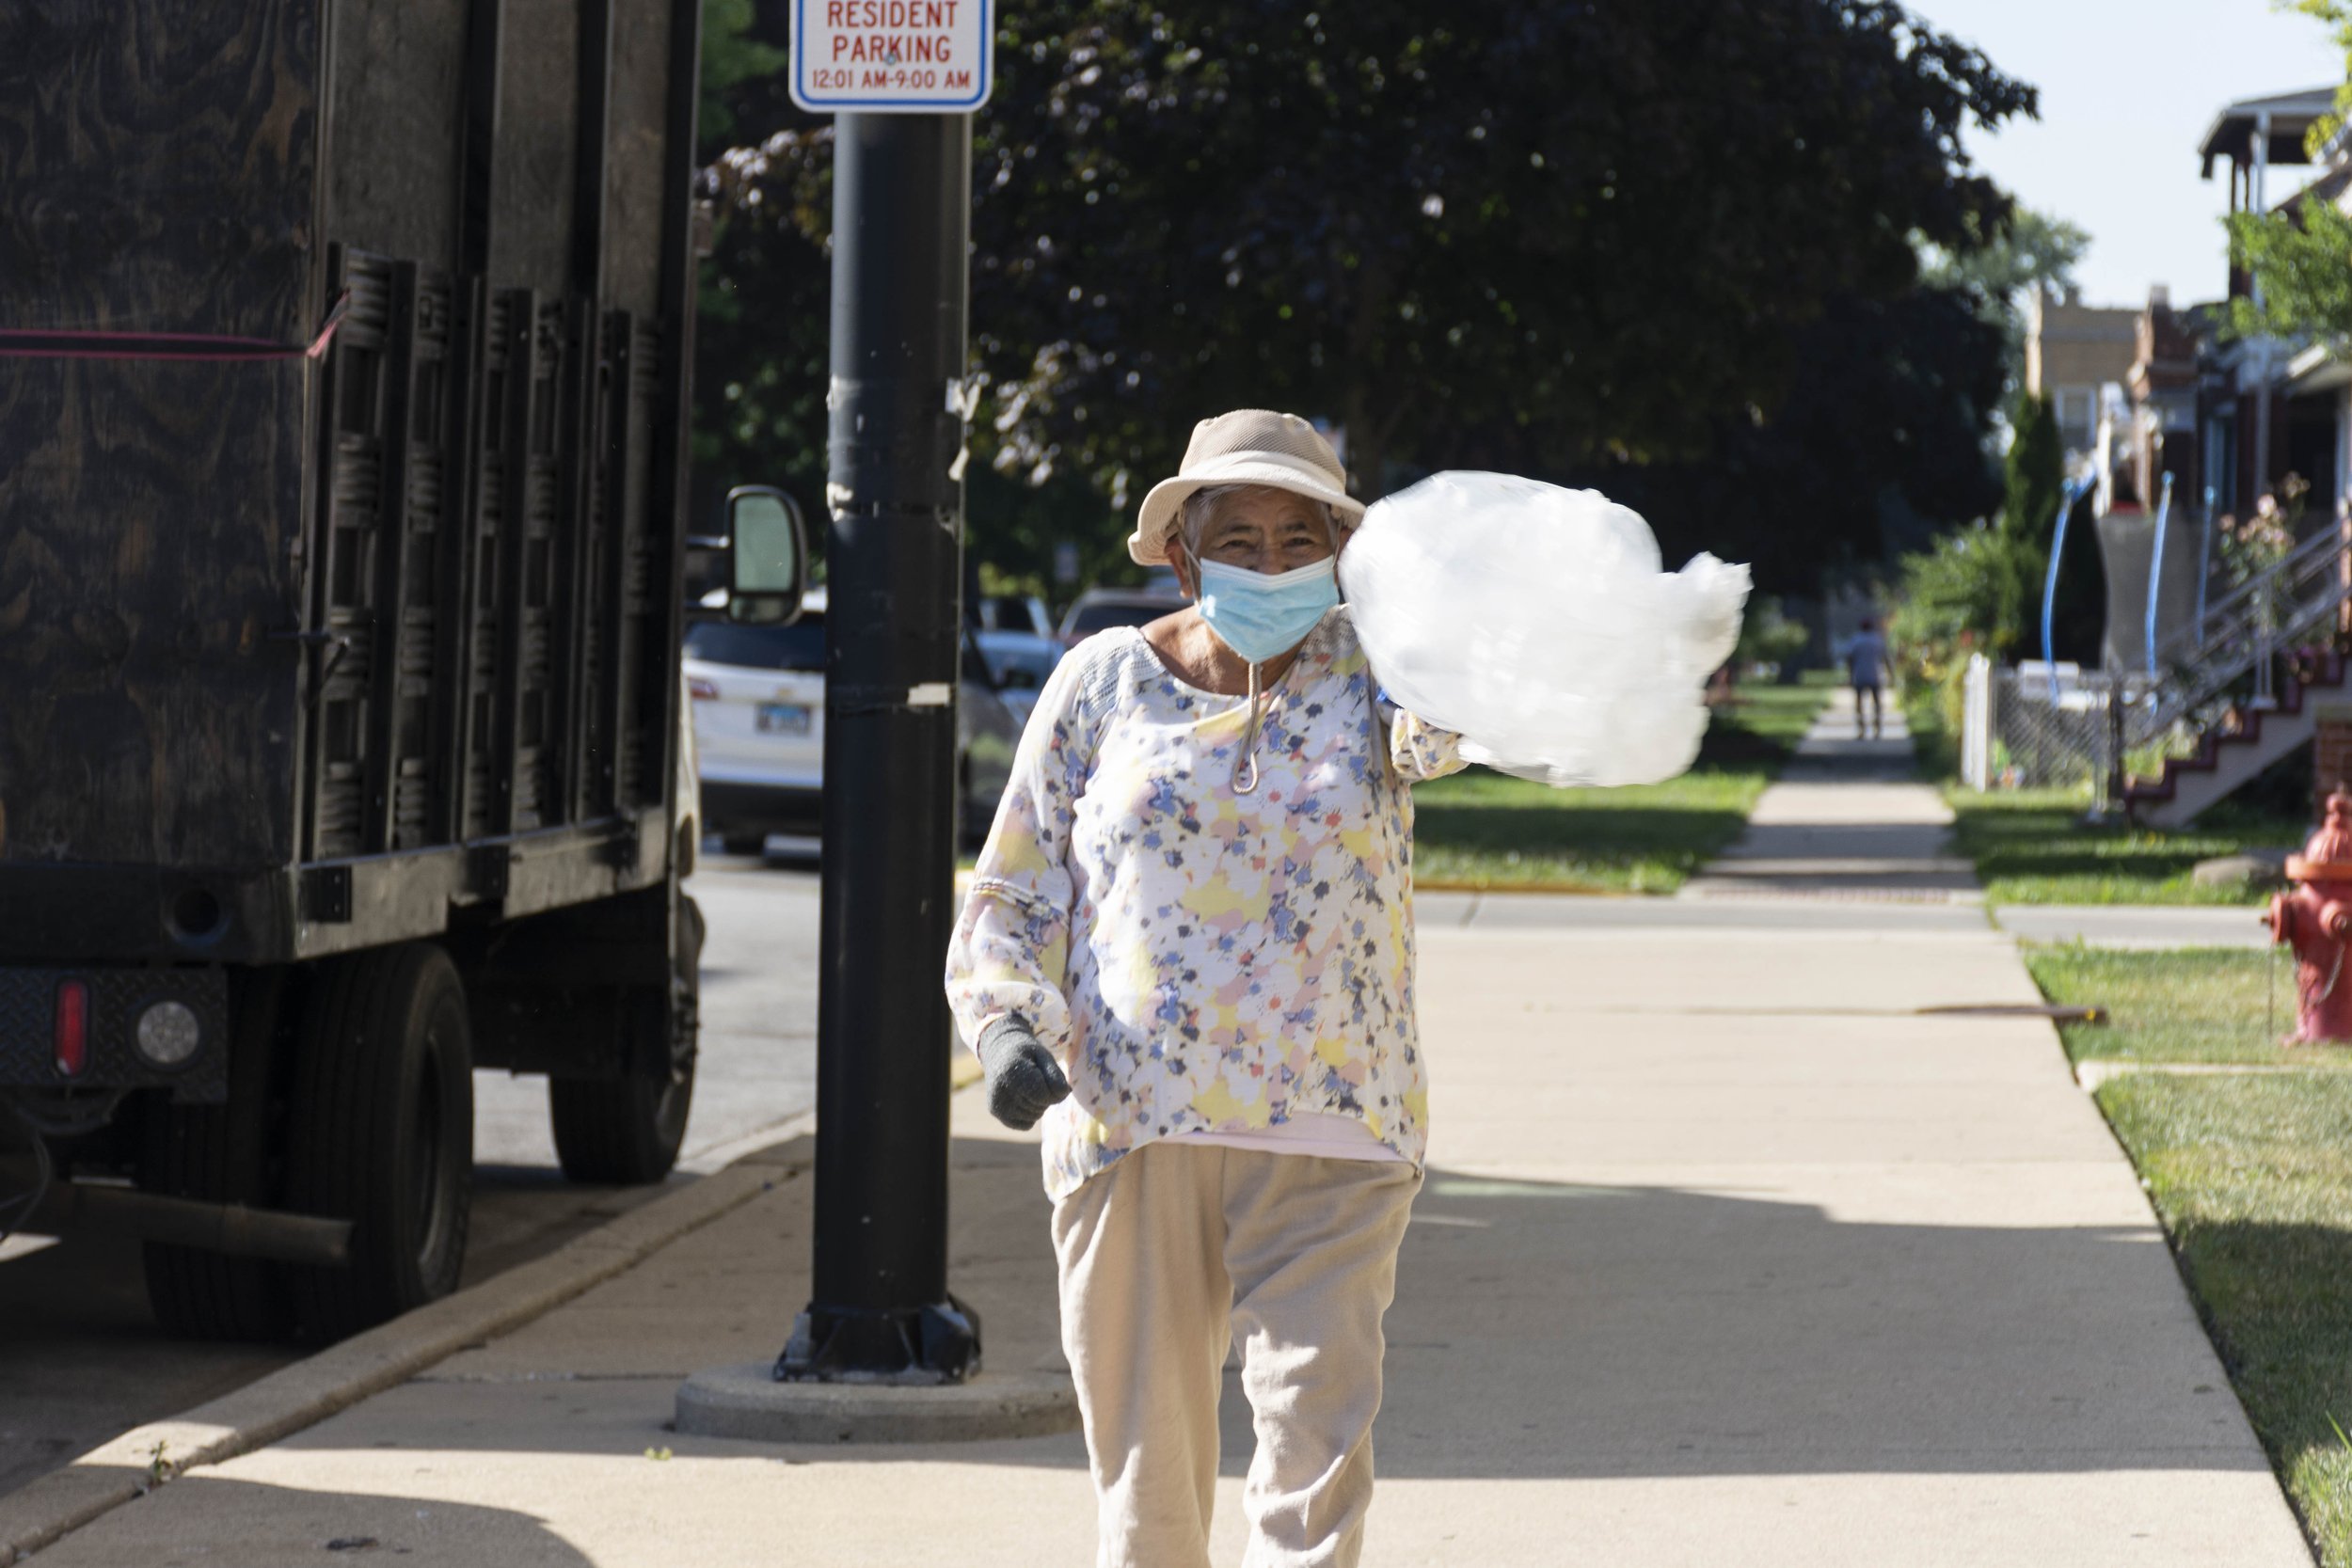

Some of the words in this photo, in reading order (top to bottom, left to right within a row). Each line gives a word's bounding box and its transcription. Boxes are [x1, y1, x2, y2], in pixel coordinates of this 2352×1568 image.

[827, 1, 958, 28] RESIDENT
[832, 35, 951, 63] PARKING
[813, 69, 853, 89] 12:01
[944, 69, 971, 89] AM
